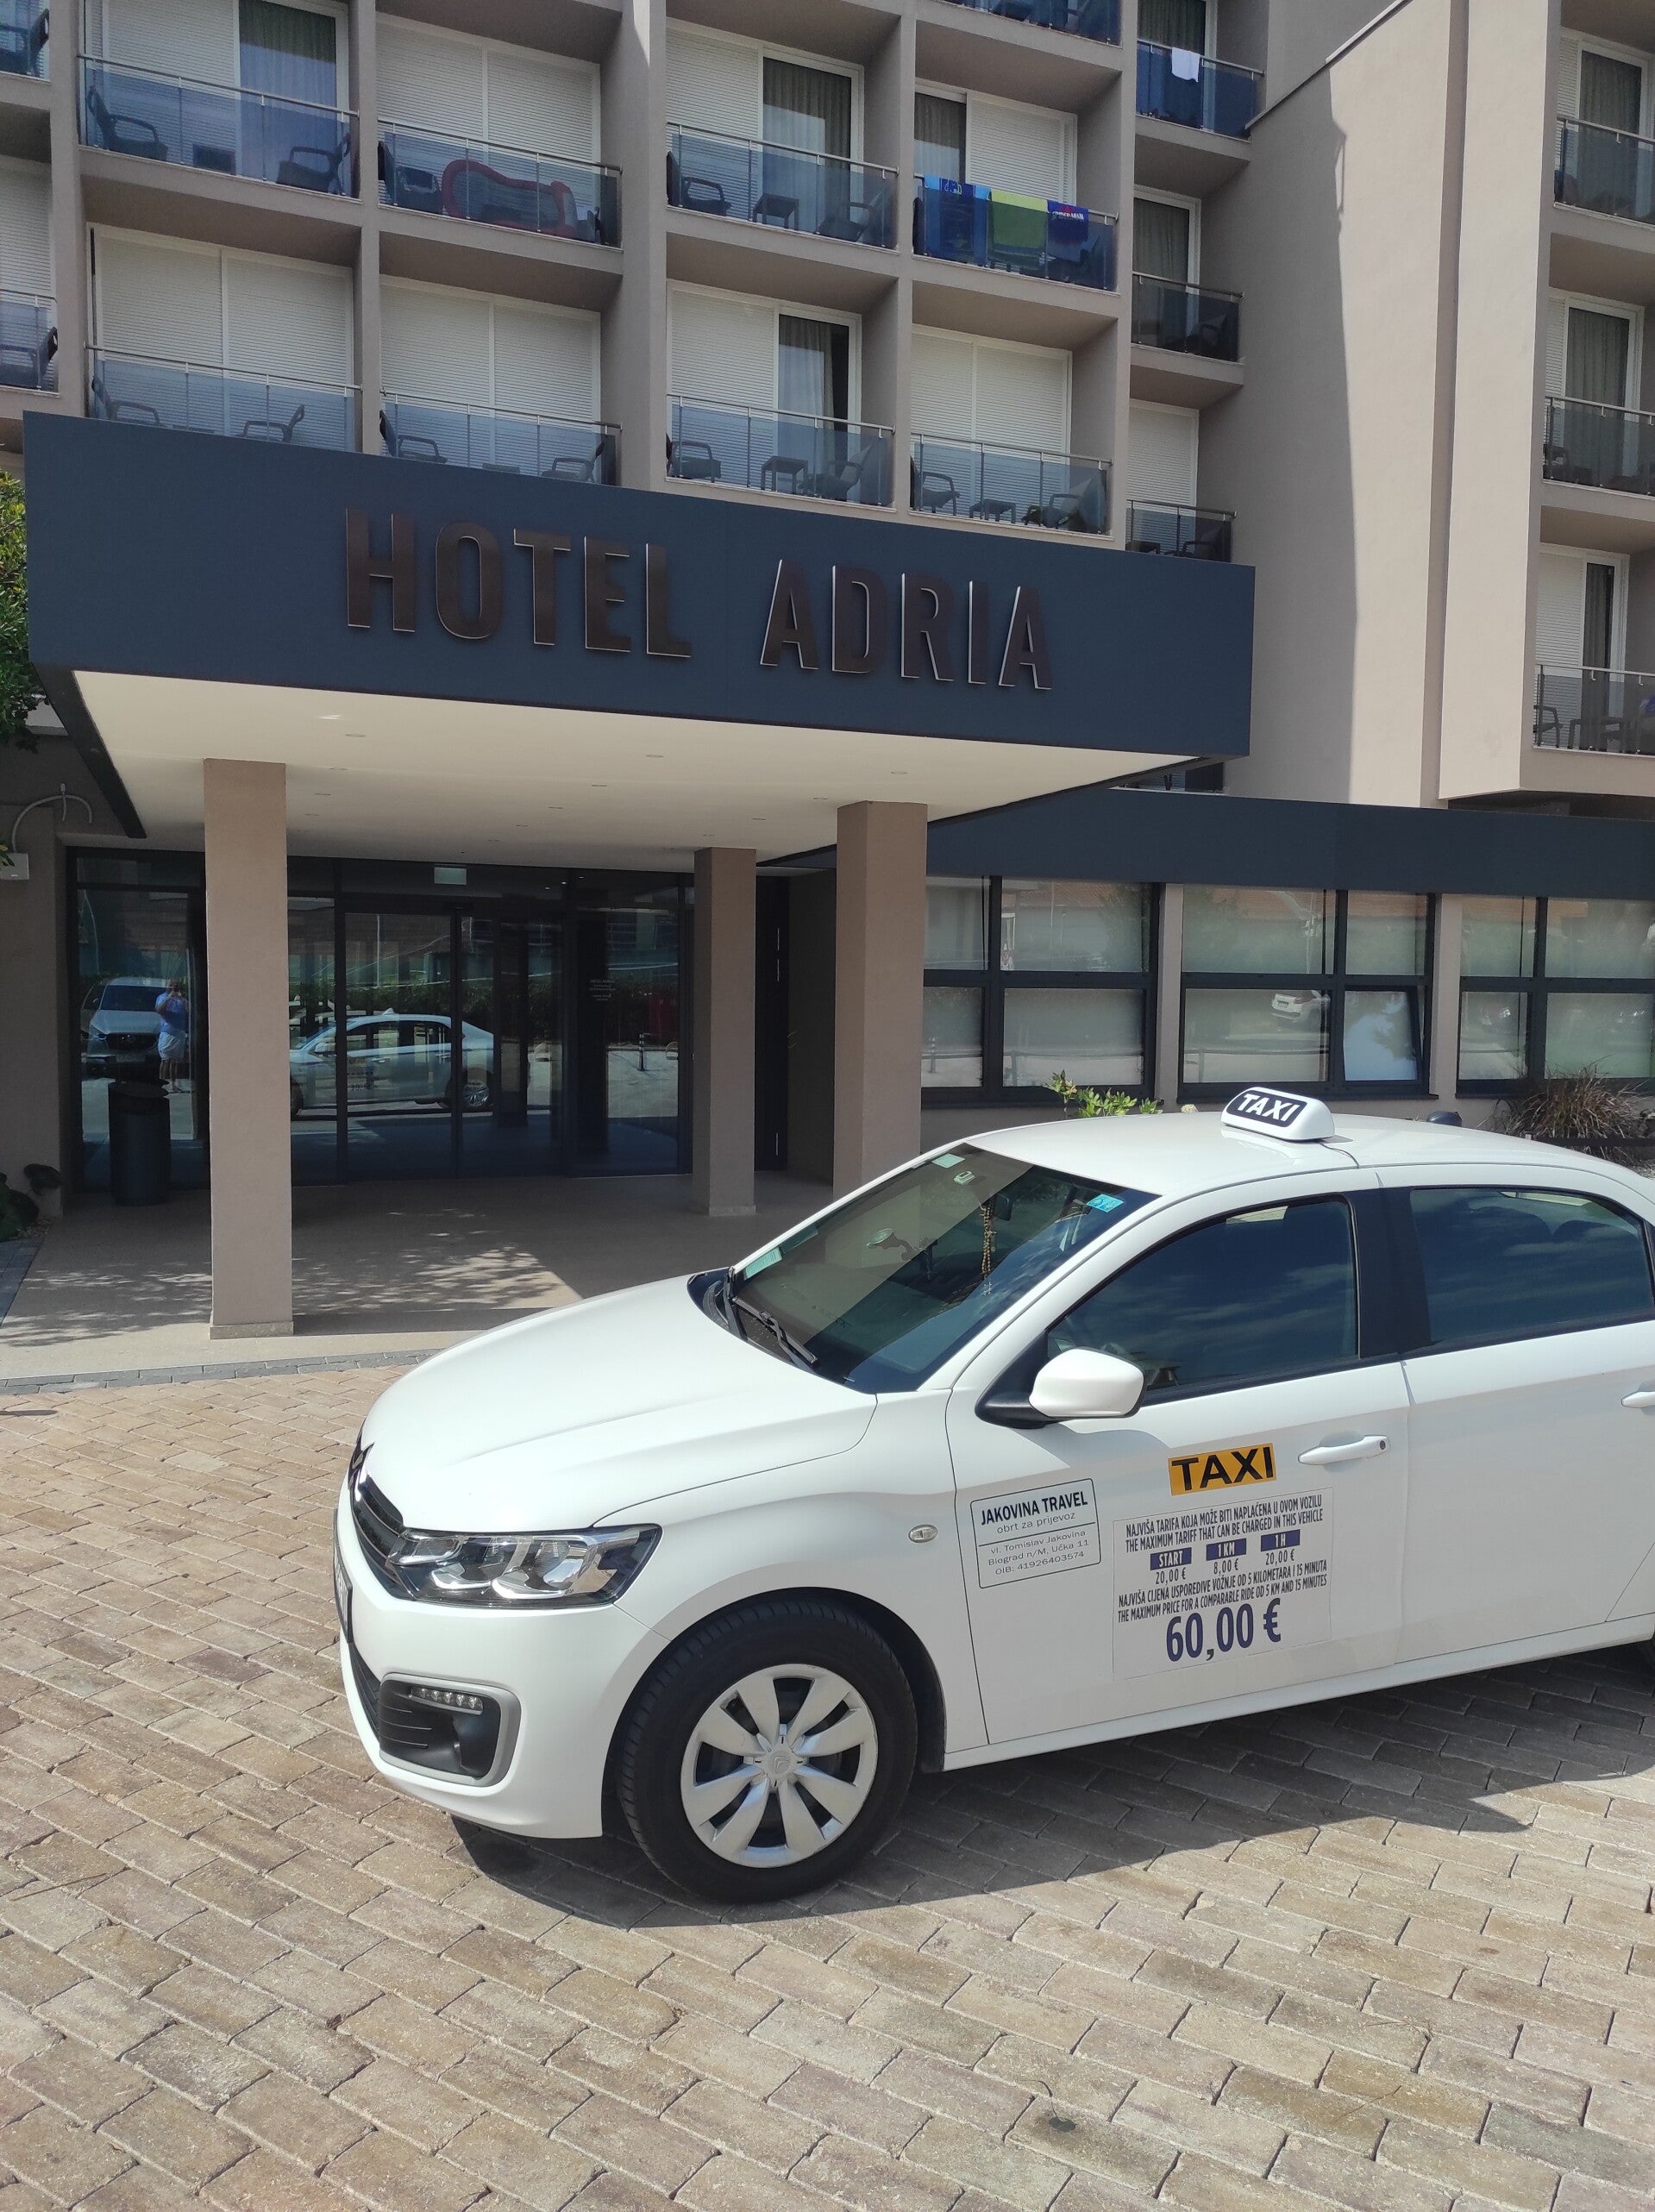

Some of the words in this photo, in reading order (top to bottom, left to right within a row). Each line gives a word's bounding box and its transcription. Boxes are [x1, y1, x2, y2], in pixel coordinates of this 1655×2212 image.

[345, 507, 692, 658] HOTEL
[760, 559, 1054, 690] ADRIA
[1237, 1093, 1301, 1122] TAXI
[1171, 1447, 1274, 1491] TAXI
[981, 1500, 1040, 1526] JAKOVINA
[1042, 1491, 1088, 1513] TRAVEL
[1126, 1519, 1155, 1538] NAJVIŠA
[1156, 1516, 1180, 1532] TARIFA
[1181, 1514, 1199, 1529] KOJA
[1200, 1509, 1218, 1526] MOŽE
[1219, 1509, 1232, 1523] BITI
[1273, 1501, 1278, 1514] U
[1280, 1498, 1299, 1513] OVOM
[1300, 1494, 1322, 1511] VOZILU
[997, 1521, 1019, 1534] obrt
[1021, 1520, 1033, 1529] za
[1037, 1513, 1075, 1528] prijevoz
[1125, 1538, 1138, 1553] THE
[1140, 1532, 1173, 1551] MAXIMUM
[1175, 1528, 1197, 1545] TARIFF
[1199, 1526, 1216, 1541] THAT
[1217, 1524, 1230, 1538] CAN
[1232, 1522, 1240, 1535] BE
[1242, 1517, 1272, 1533] CHARGED
[1273, 1514, 1281, 1529] IN
[1282, 1513, 1297, 1526] THIS
[1298, 1507, 1323, 1525] VEHICLE
[988, 1553, 1024, 1566] Biograd
[1051, 1542, 1075, 1552] Učka
[1077, 1539, 1089, 1548] 11
[1004, 1537, 1044, 1551] Tomislav
[1046, 1530, 1086, 1544] Jakovina
[1218, 1543, 1221, 1557] 1
[1223, 1542, 1235, 1557] KM
[1275, 1534, 1278, 1548] 1
[1280, 1533, 1286, 1547] H
[995, 1566, 1014, 1576] OIB:
[1018, 1551, 1085, 1570] 41926403574
[1158, 1551, 1183, 1568] START
[1213, 1559, 1232, 1576] 8,00
[1234, 1557, 1238, 1571] €
[1265, 1550, 1288, 1566] 20,00
[1290, 1548, 1295, 1561] €
[1119, 1589, 1145, 1607] NAJVIŠA
[1147, 1587, 1169, 1602] CIJENA
[1171, 1580, 1211, 1599] USPOREDIVE
[1213, 1573, 1235, 1592] VOŽNJE
[1237, 1573, 1247, 1587] OD
[1248, 1572, 1252, 1585] 5
[1253, 1564, 1291, 1584] KILOMETARA
[1296, 1563, 1303, 1576] 15
[1304, 1559, 1327, 1575] MINUTA
[1156, 1568, 1179, 1585] 20,00
[1182, 1567, 1187, 1580] €
[1118, 1609, 1130, 1623] THE
[1131, 1603, 1161, 1621] MAXIMUM
[1163, 1600, 1180, 1614] PRICE
[1182, 1597, 1194, 1613] FOR
[1194, 1596, 1199, 1609] A
[1201, 1589, 1239, 1608] COMPARABLE
[1240, 1587, 1255, 1601] RIDE
[1256, 1585, 1264, 1598] OD
[1266, 1583, 1269, 1597] 5
[1271, 1582, 1280, 1595] KM
[1281, 1580, 1294, 1594] AND
[1295, 1578, 1301, 1592] 15
[1302, 1573, 1328, 1590] MINUTES
[1166, 1603, 1254, 1662] 60,00
[1263, 1597, 1282, 1643] €
